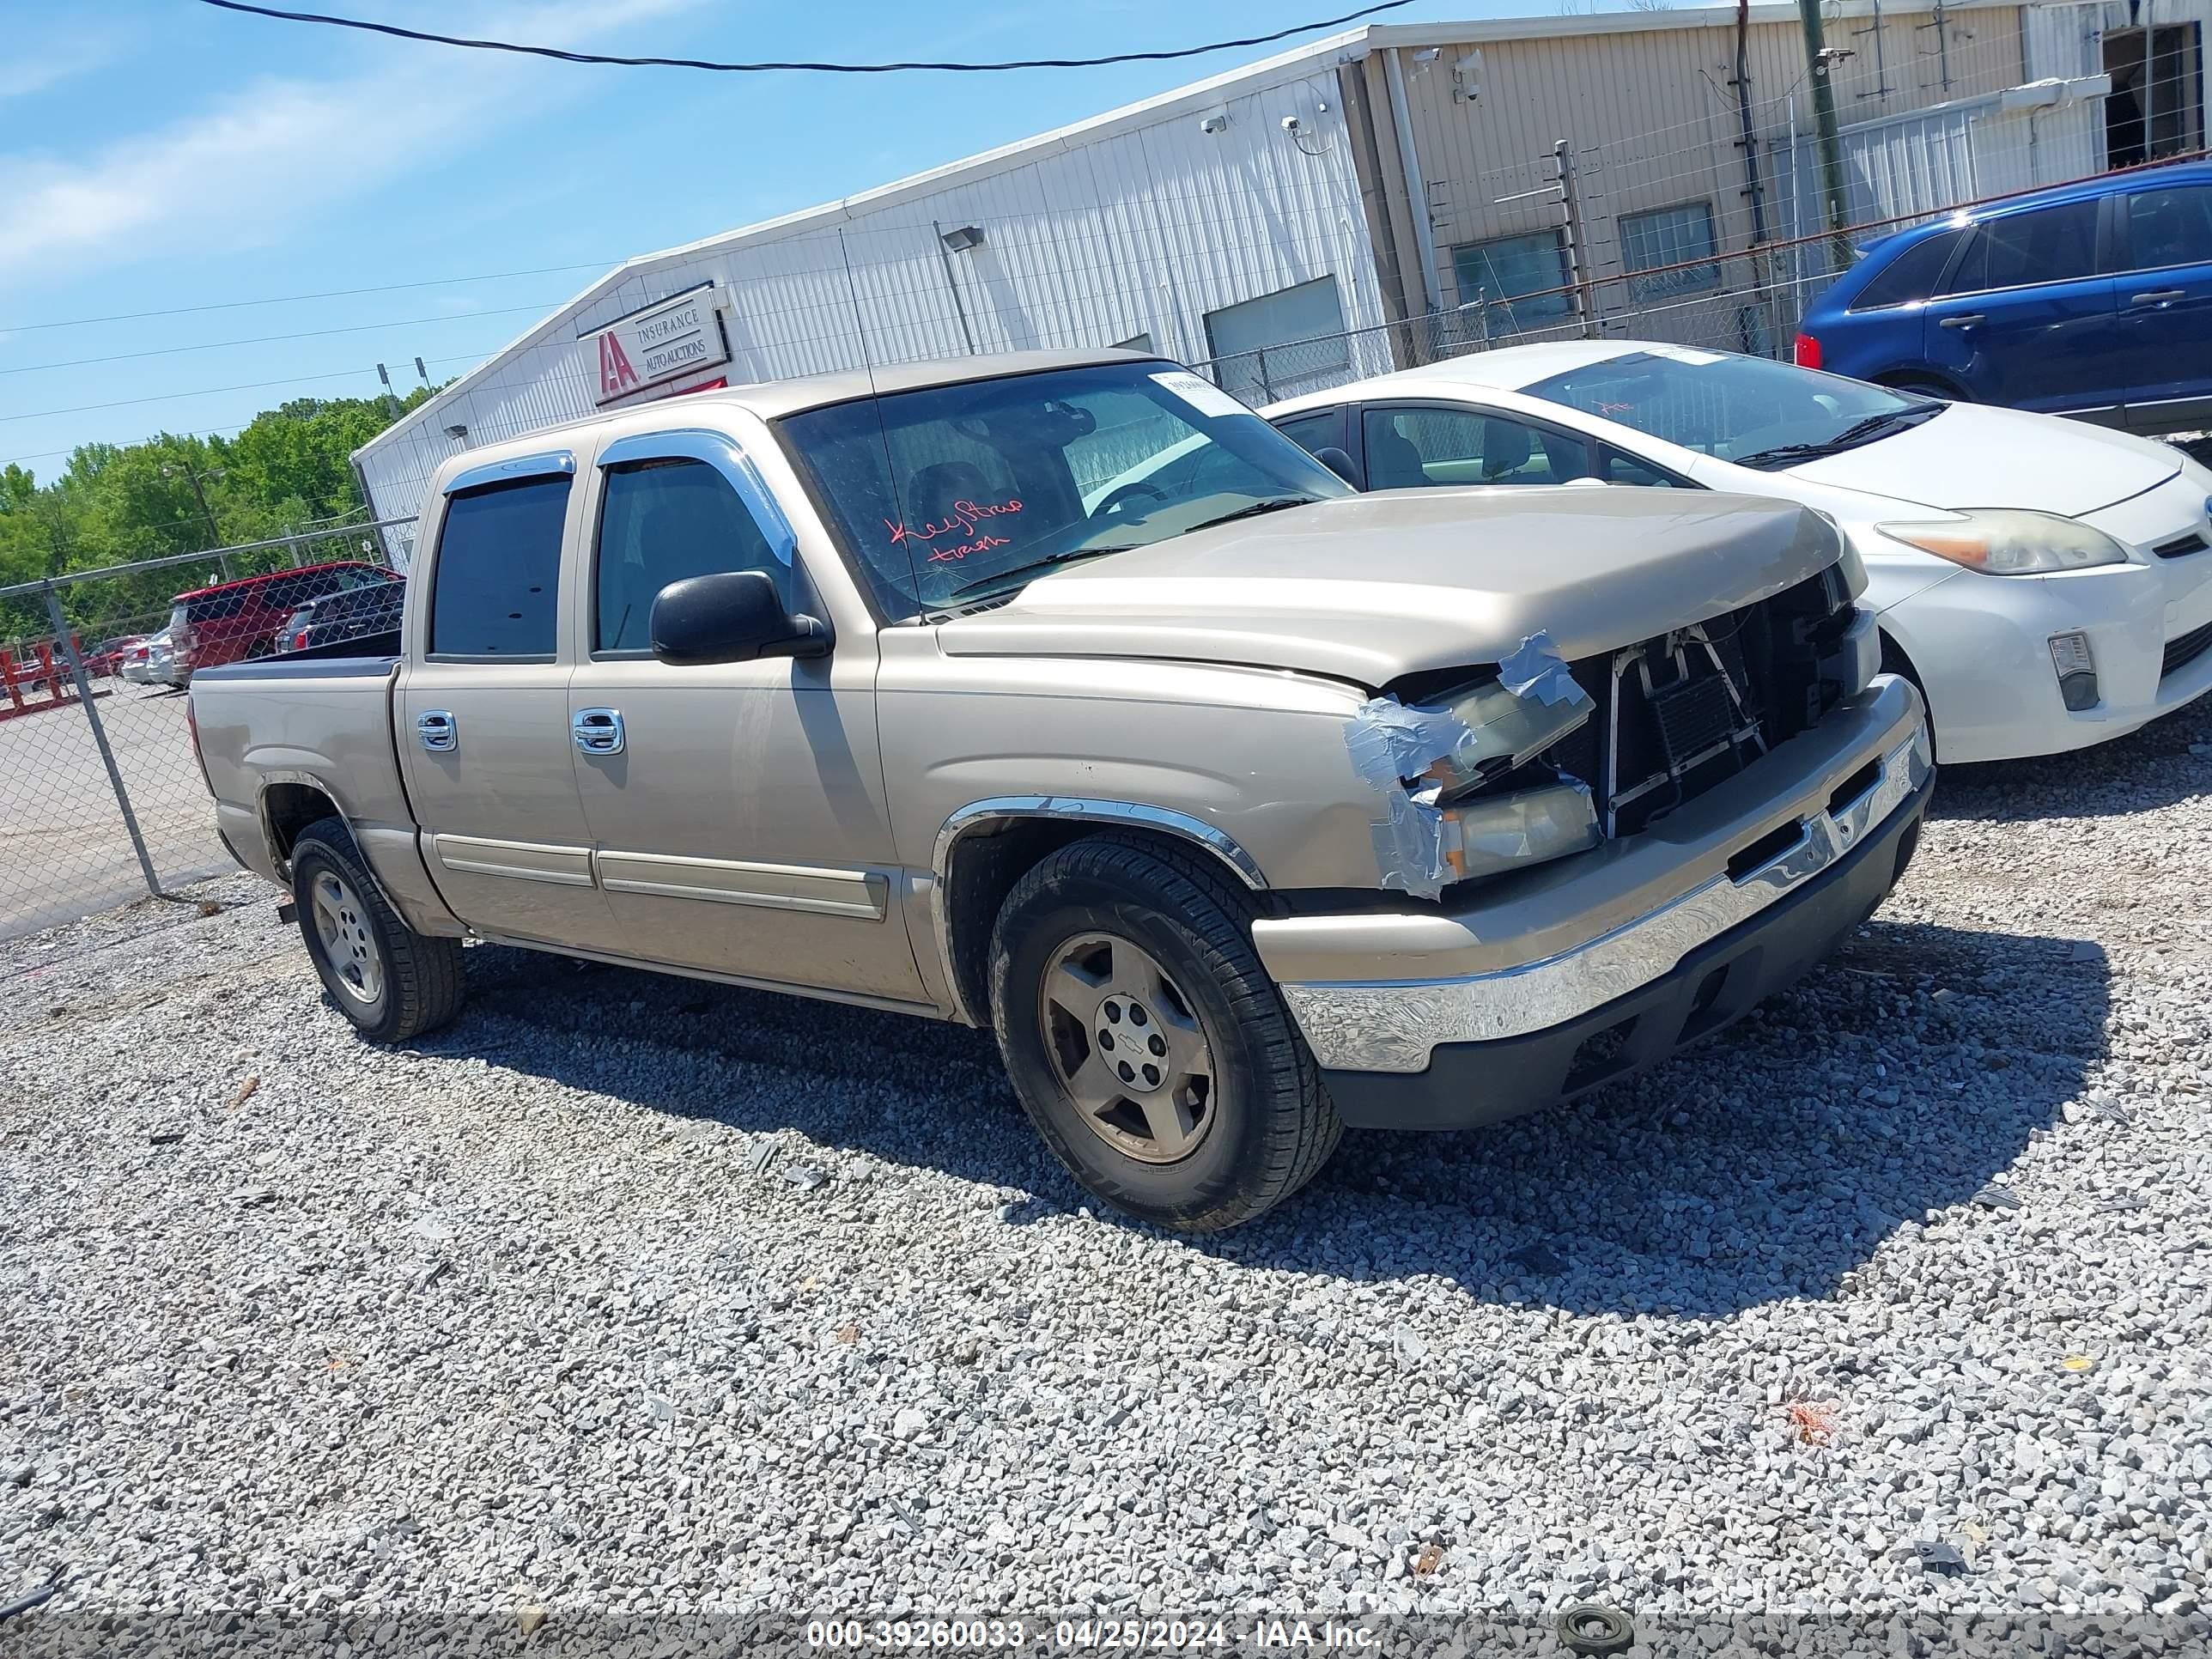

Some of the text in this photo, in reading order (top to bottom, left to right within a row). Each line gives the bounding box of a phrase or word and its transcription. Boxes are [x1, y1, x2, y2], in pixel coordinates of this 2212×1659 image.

[638, 308, 699, 343] INSURANCE
[647, 339, 706, 372] AUTO AUCTIONS
